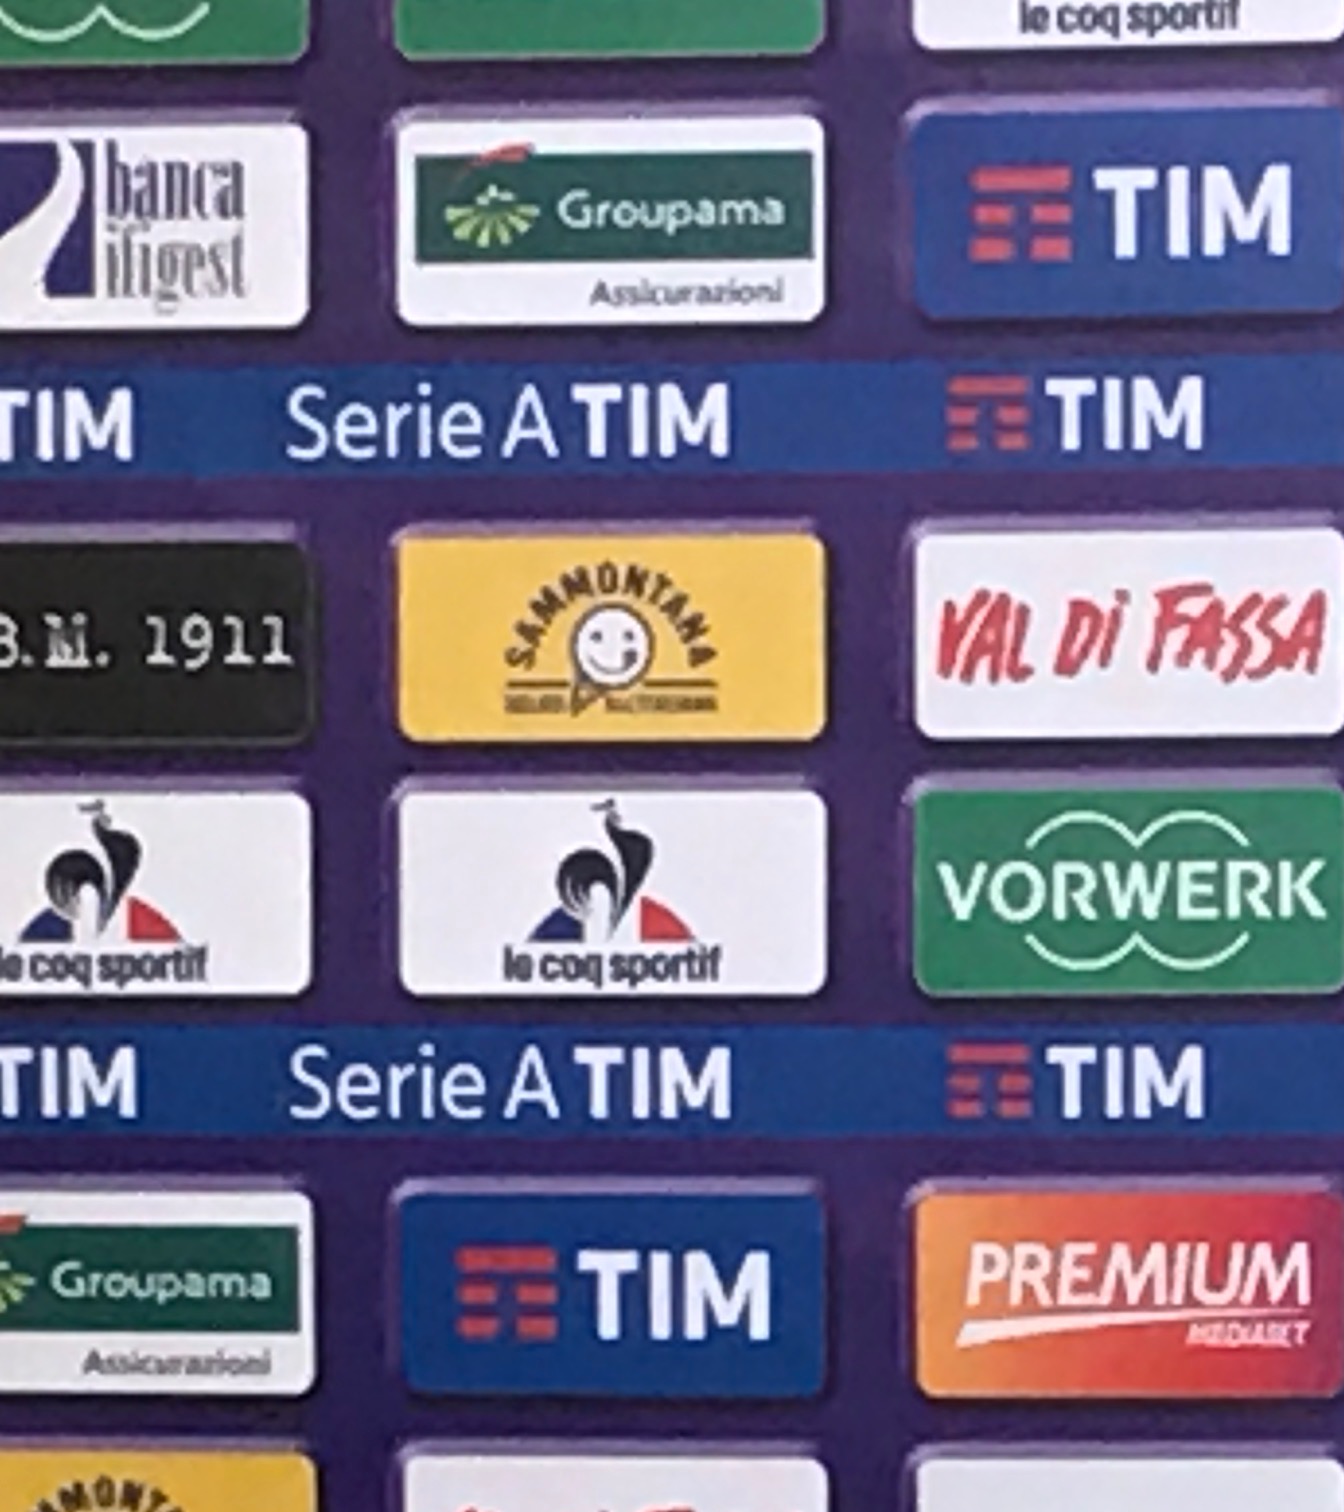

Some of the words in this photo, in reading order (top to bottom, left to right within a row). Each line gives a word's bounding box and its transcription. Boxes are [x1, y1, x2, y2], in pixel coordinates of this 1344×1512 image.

[1056, 4, 1120, 39] coq
[1126, 0, 1241, 38] sportif
[105, 139, 246, 219] banca
[1093, 164, 1292, 260] TIM
[557, 190, 785, 236] Groupama
[589, 277, 784, 308] Assicurazioni
[287, 383, 484, 459] Serie
[502, 385, 560, 459] A
[573, 383, 730, 458] TIM
[1045, 376, 1203, 452] TIM
[145, 612, 294, 671] 1911
[504, 560, 718, 671] SAMMONTANA
[936, 589, 1033, 684] VAL
[936, 859, 1329, 924] VORWERK
[29, 954, 92, 989] coq
[98, 943, 207, 989] sportif
[503, 945, 533, 982] le
[540, 953, 603, 989] coq
[609, 945, 721, 988] sportif
[289, 1043, 486, 1120] Serie
[503, 1045, 561, 1120] A
[574, 1044, 733, 1120] TIM
[1046, 1044, 1204, 1120] TIM
[50, 1260, 273, 1305] Groupama
[576, 1248, 772, 1342] TIM
[964, 1241, 1312, 1307] PREMIUM
[82, 1349, 272, 1379] Assicurazioni
